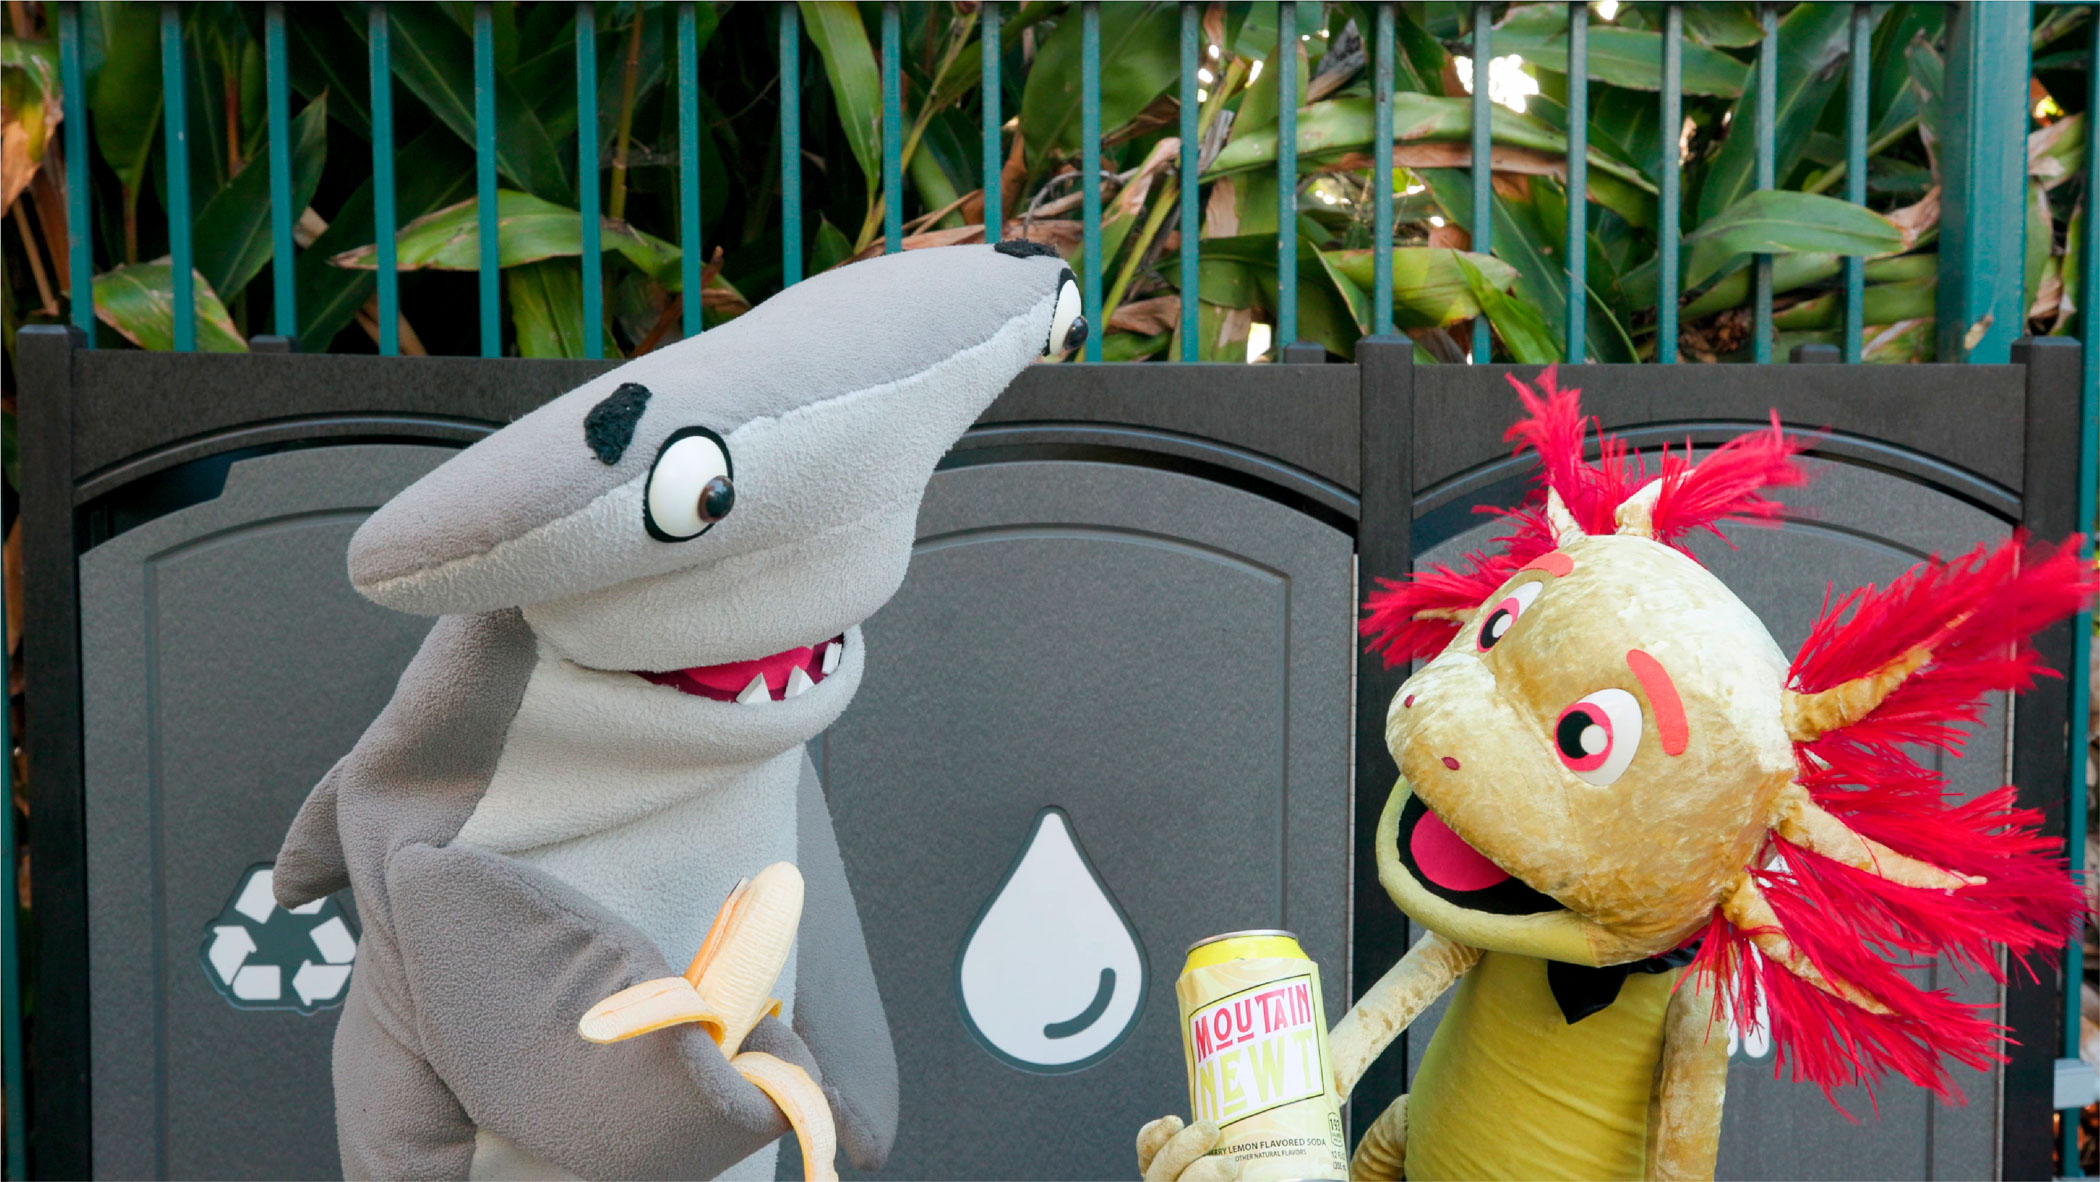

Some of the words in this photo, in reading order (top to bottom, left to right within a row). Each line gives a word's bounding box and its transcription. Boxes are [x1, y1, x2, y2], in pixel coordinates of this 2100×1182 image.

[1195, 983, 1312, 1063] MOUTAIN
[1199, 1028, 1313, 1121] NEWT
[1228, 1142, 1259, 1154] LEMON
[1260, 1138, 1305, 1149] FLAVORED
[1307, 1138, 1327, 1146] SODA
[1235, 1153, 1254, 1162] OTHER
[1254, 1150, 1281, 1159] NATURAL
[1281, 1149, 1307, 1157] FLAVORS
